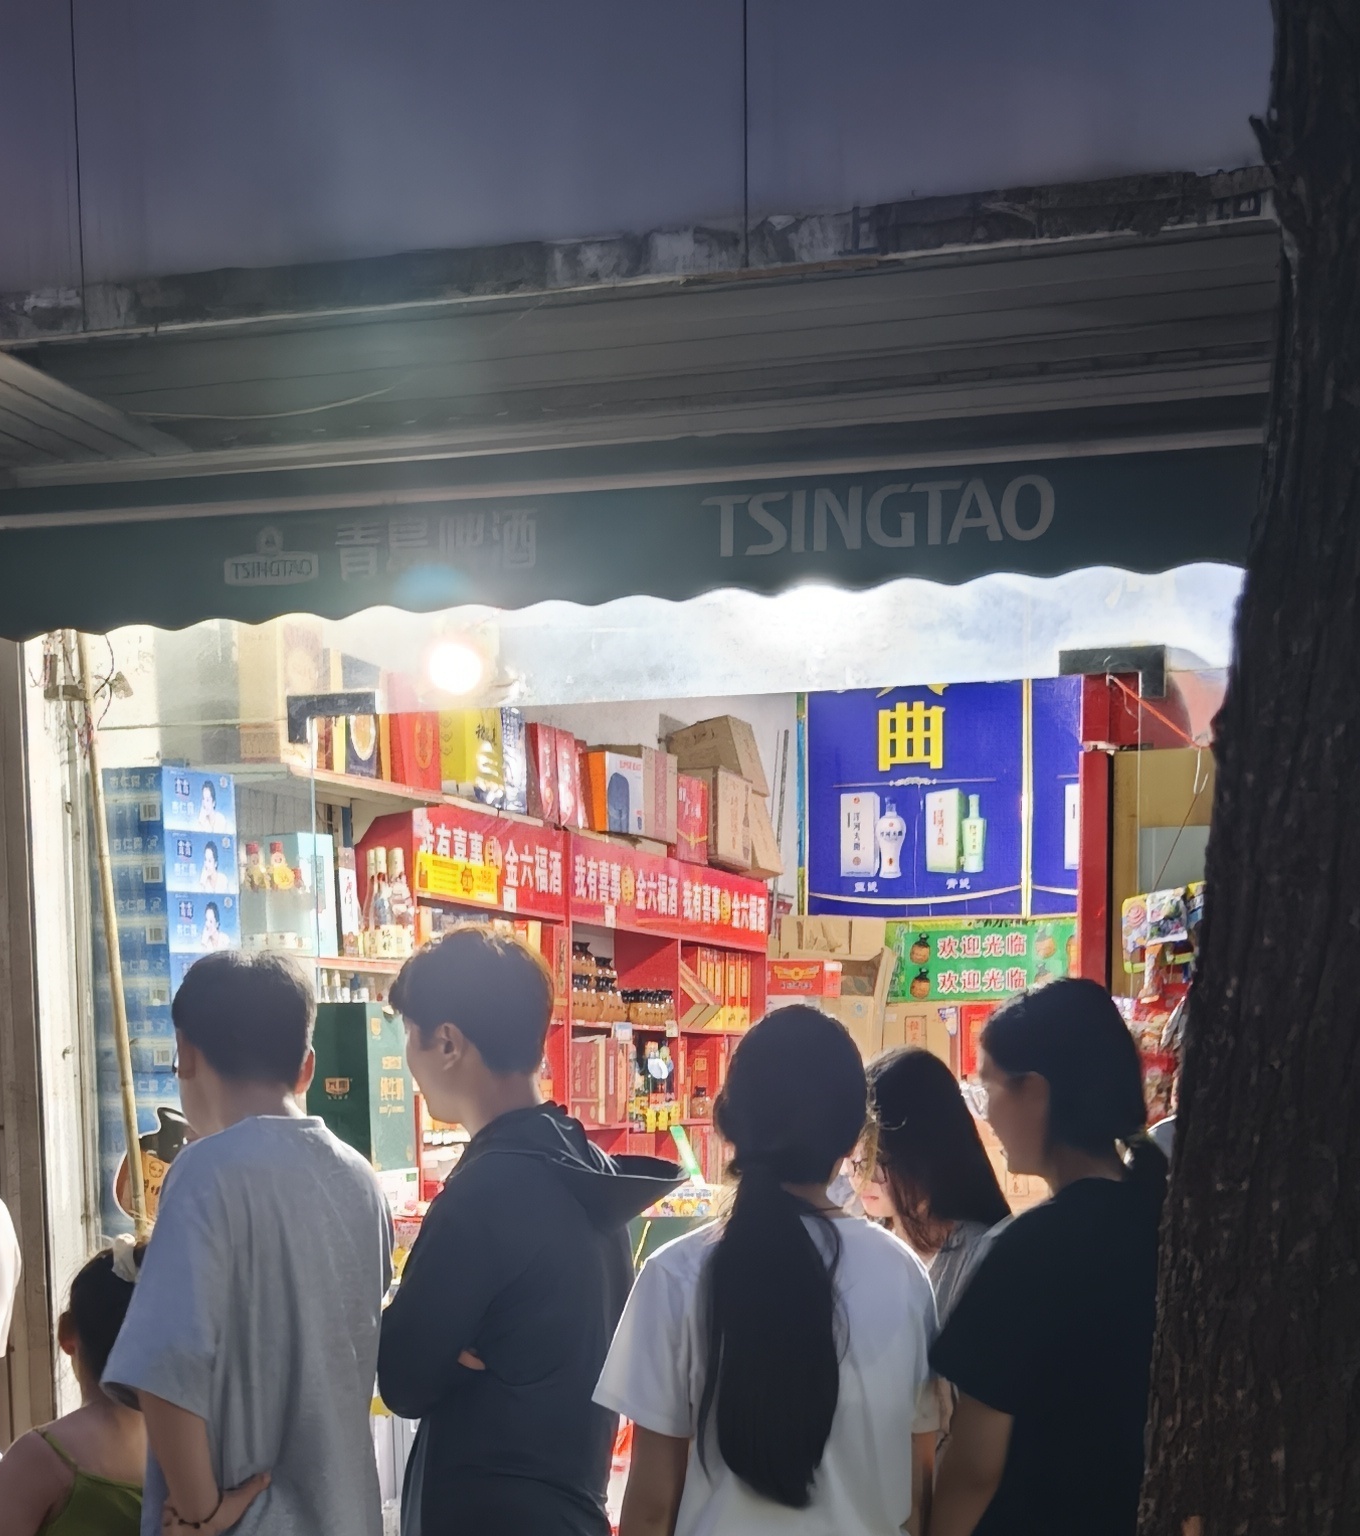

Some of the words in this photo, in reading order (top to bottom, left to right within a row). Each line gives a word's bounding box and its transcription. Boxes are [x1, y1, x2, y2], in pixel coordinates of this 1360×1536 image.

[700, 474, 1055, 557] TSINGTAO
[875, 685, 947, 772] 曲
[504, 839, 563, 896] 金六福酒
[574, 854, 621, 905] 我有喜事
[635, 869, 678, 917] 金六福酒
[731, 891, 766, 933] 金六福酒
[937, 932, 1028, 960] 欢迎光临
[937, 967, 1028, 994] 欢迎光临
